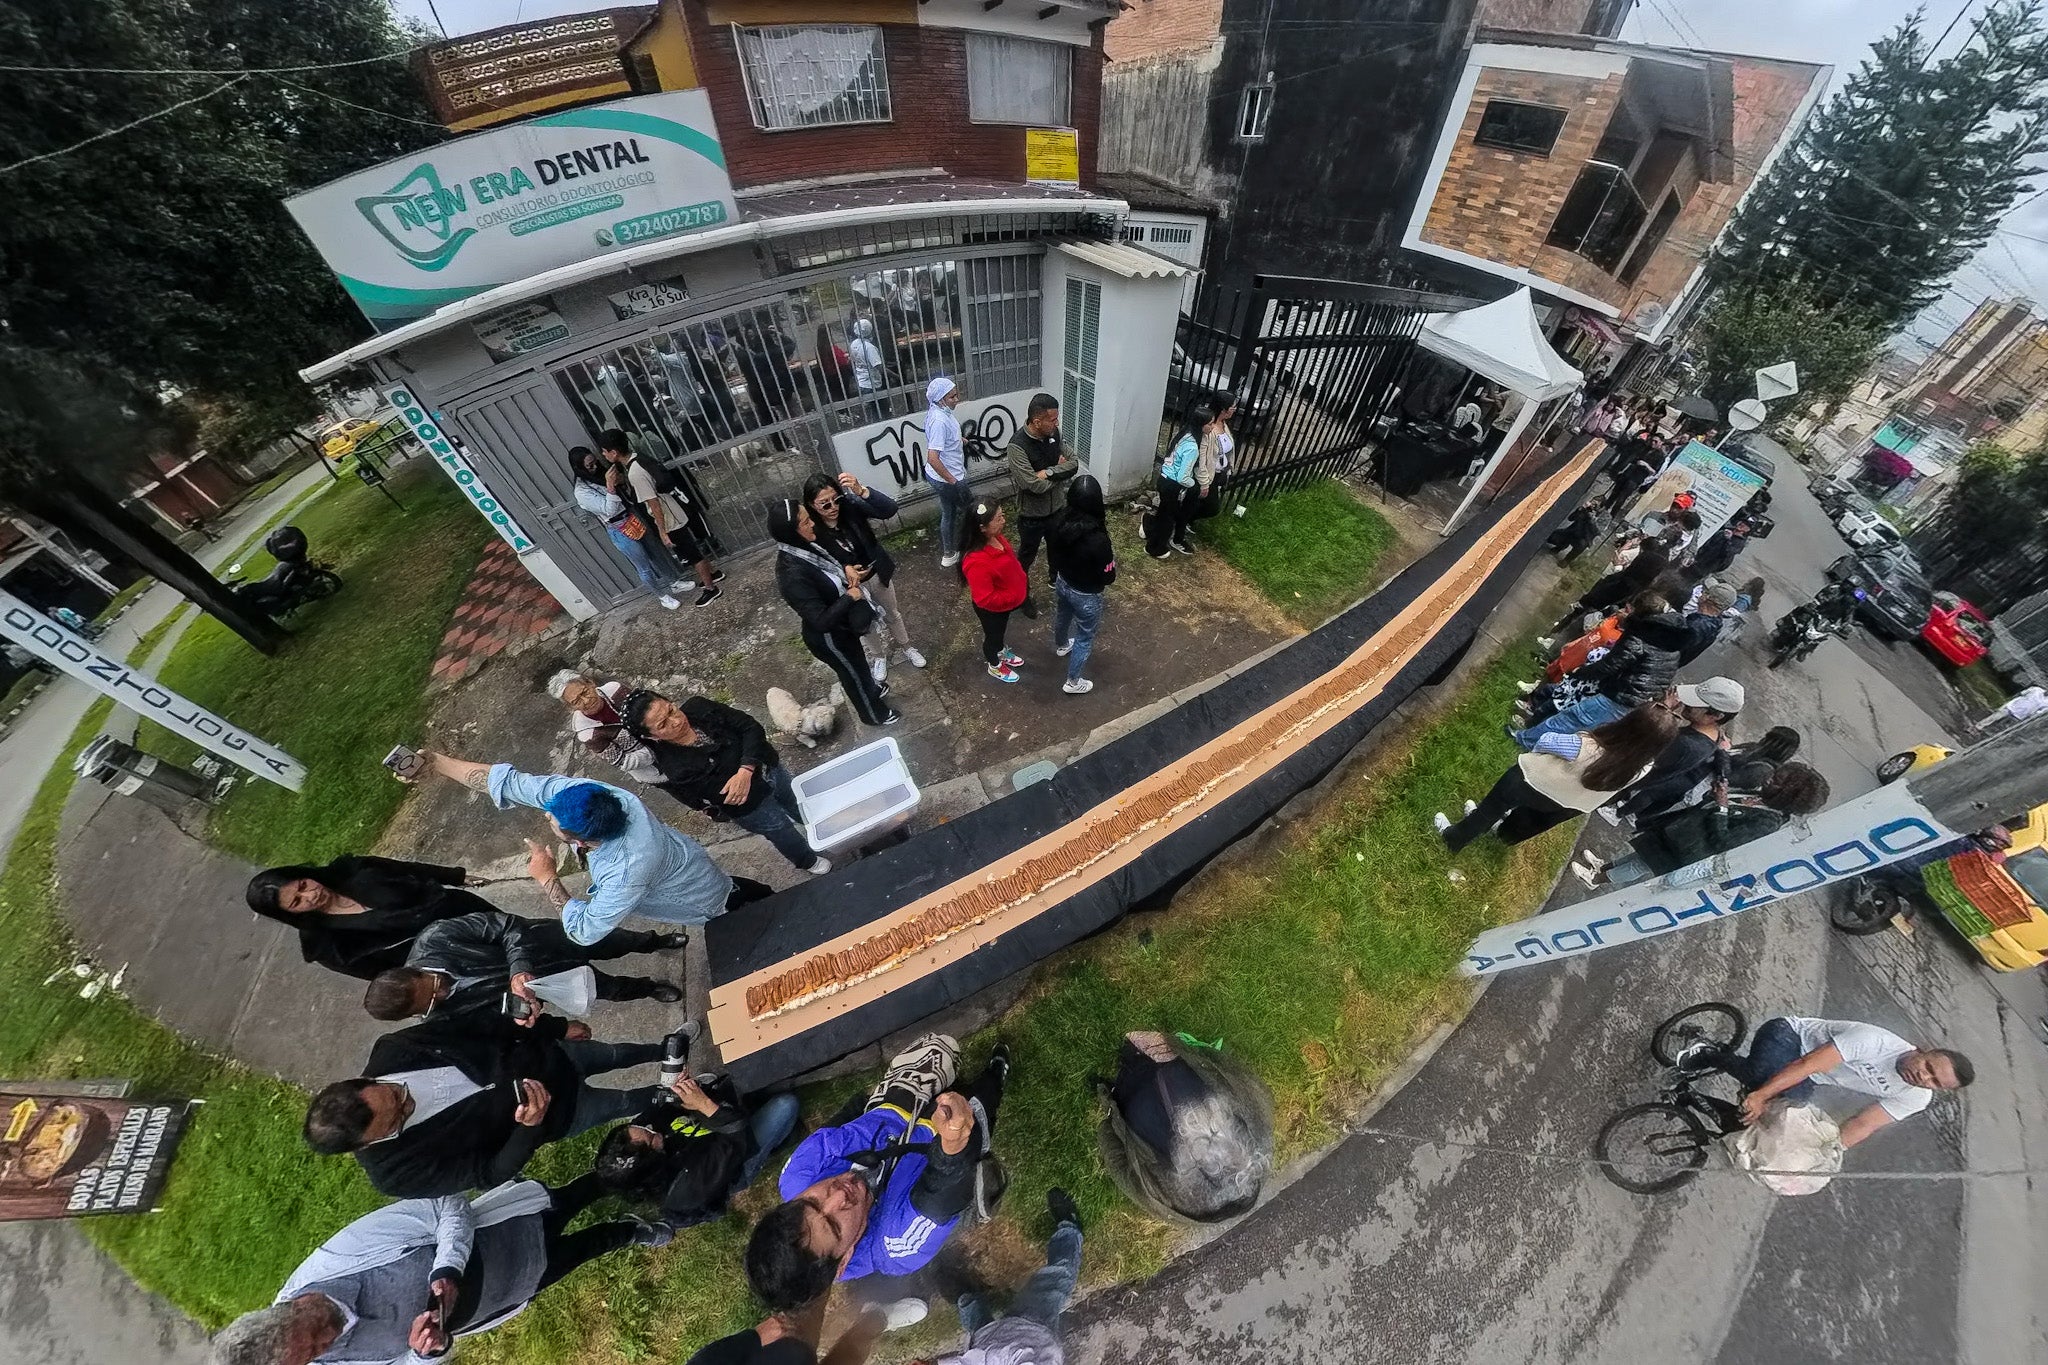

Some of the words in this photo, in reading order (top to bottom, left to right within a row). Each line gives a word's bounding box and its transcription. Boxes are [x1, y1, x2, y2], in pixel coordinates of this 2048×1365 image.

[392, 184, 466, 231] NEW
[469, 166, 536, 205] ERA
[534, 138, 650, 186] DENTAL
[476, 194, 558, 228] CONSULTORIO
[620, 204, 722, 241] 3224022787
[626, 289, 649, 303] Kra
[650, 282, 668, 297] 70
[648, 295, 665, 309] 16
[666, 290, 688, 304] Sur
[390, 389, 532, 551] ODONTOLOGIA
[4, 607, 291, 777] ODONTOLOGIA
[1468, 816, 1940, 972] ODONTOLOGIA
[67, 1167, 102, 1210] SOPAS
[91, 1169, 125, 1210] PLATOS
